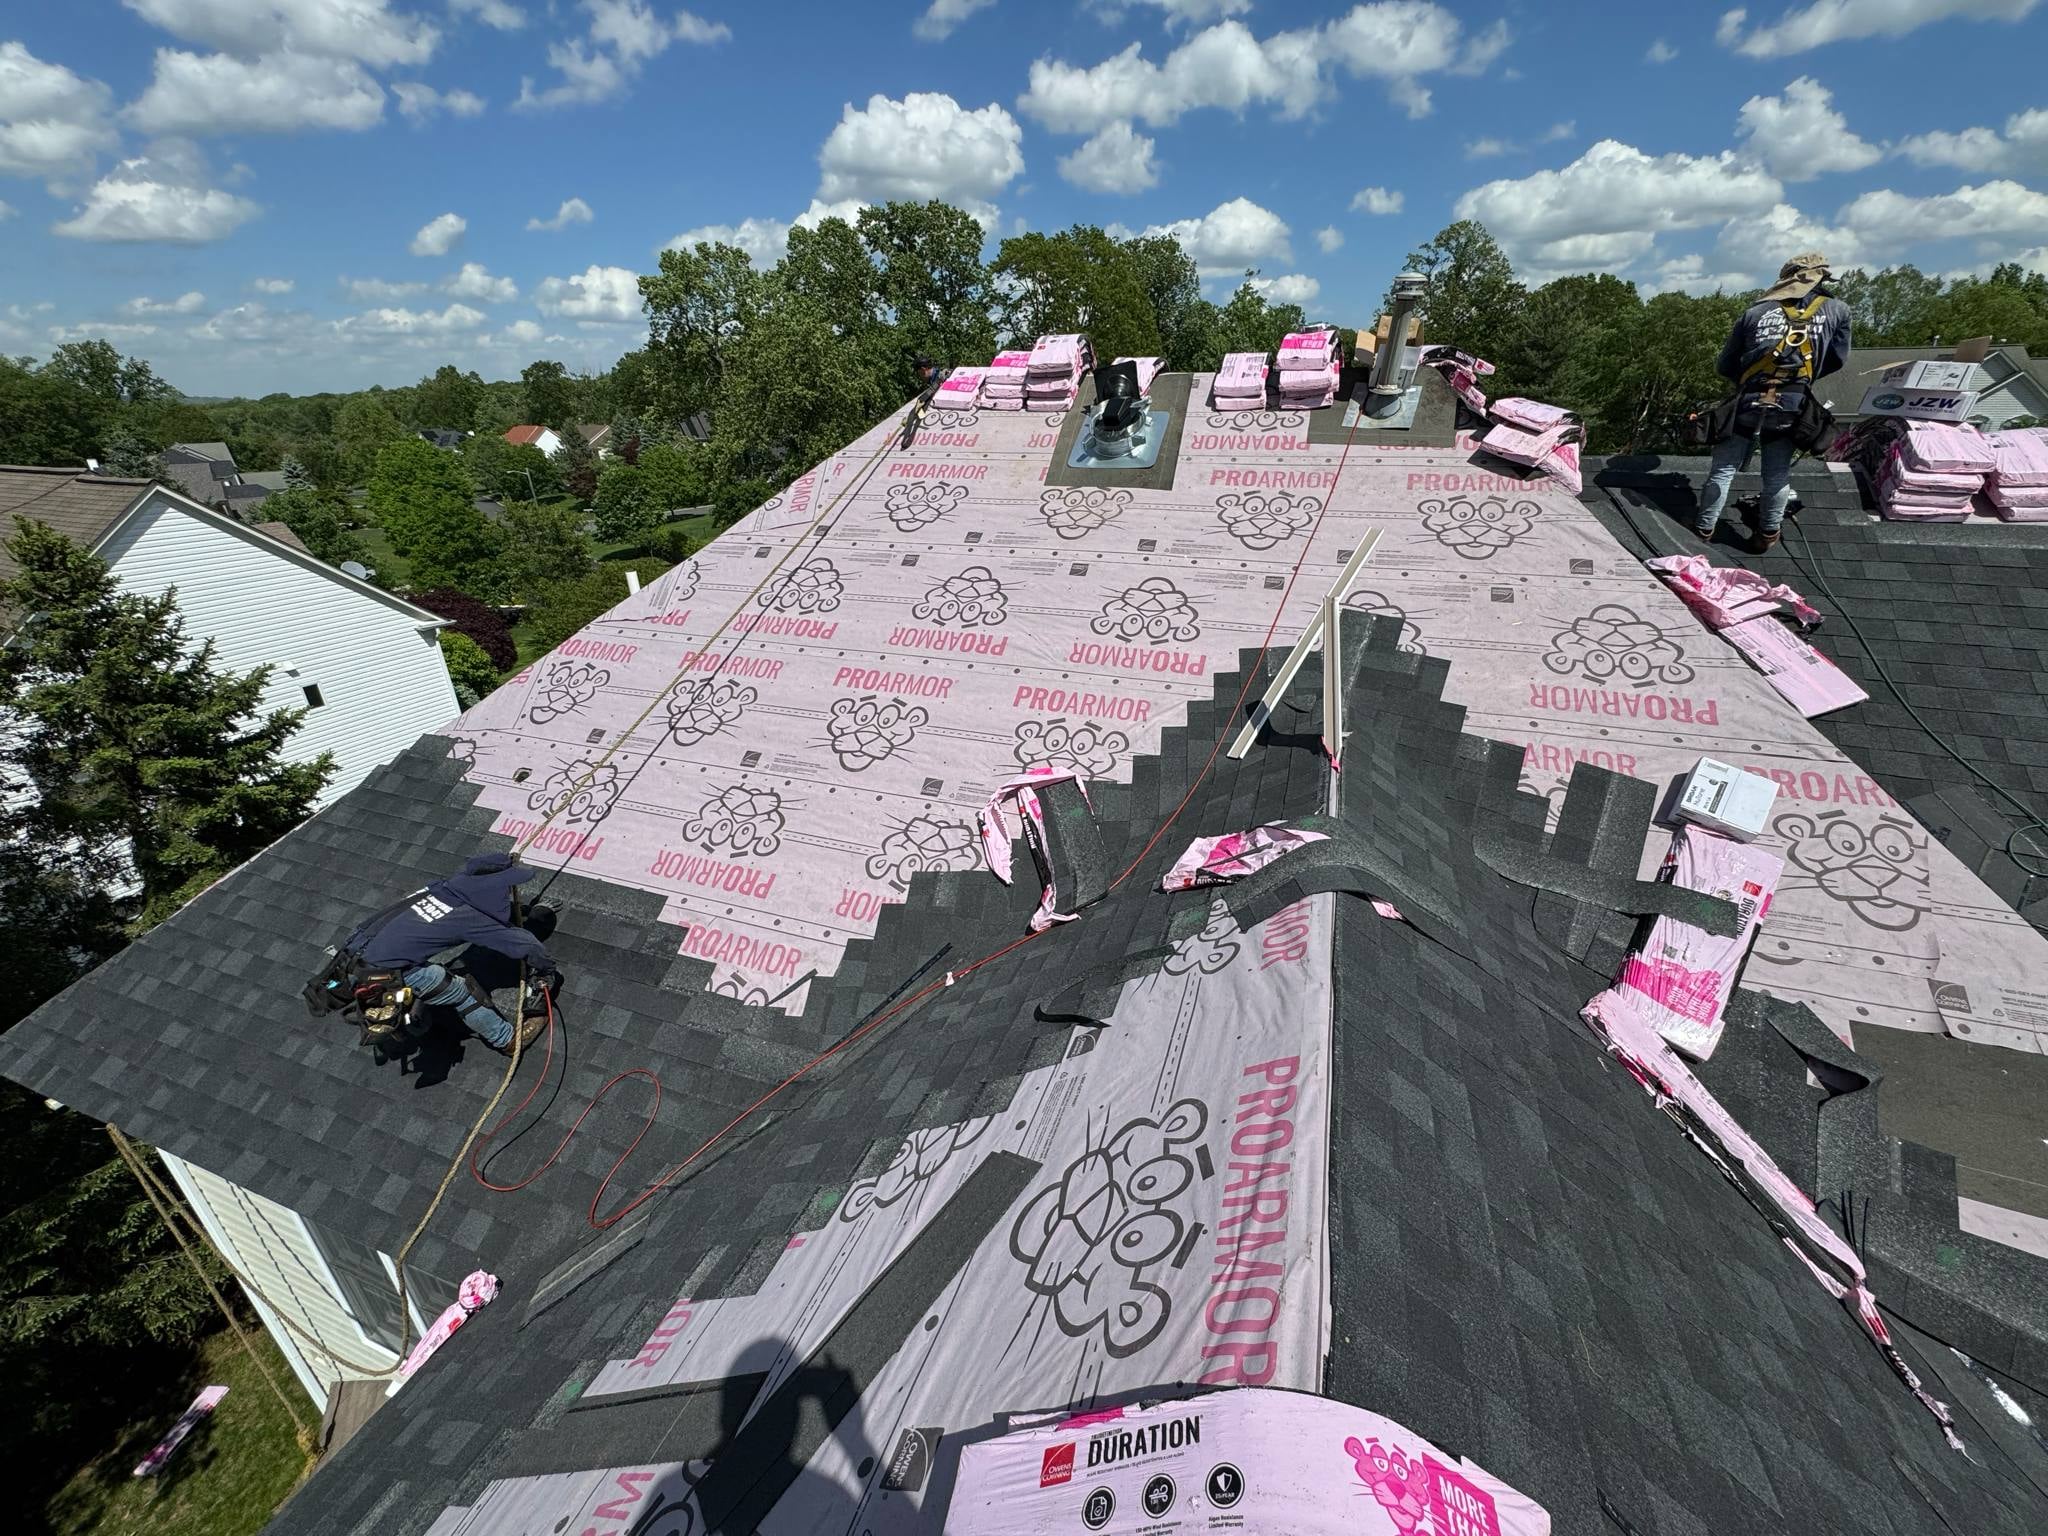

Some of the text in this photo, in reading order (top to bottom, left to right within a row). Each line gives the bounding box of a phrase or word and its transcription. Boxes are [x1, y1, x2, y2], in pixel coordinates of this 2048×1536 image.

[1906, 406, 1956, 414] INTERNATIONAL
[1909, 396, 1961, 409] JZW
[1191, 434, 1309, 450] PROARMOR
[887, 463, 988, 480] PROARMOR
[1210, 469, 1338, 488] PROARMOR
[732, 613, 838, 640] PROARMOR
[888, 627, 1008, 657] PROARMOR
[677, 650, 784, 680] PROARMOR
[1068, 642, 1207, 676] PROARMOR
[832, 666, 955, 698] PROARMOR
[1012, 685, 1151, 722] PROARMOR
[1529, 683, 1720, 727] PROARMOR
[649, 849, 778, 900] PROARMOR
[680, 919, 802, 978] ROARMOR
[1198, 1055, 1301, 1386] PROARMOR
[1087, 1415, 1200, 1467] DURATION
[886, 1432, 915, 1487] CORNING
[894, 1442, 918, 1487] OWENS
[1048, 1462, 1072, 1474] OWENS
[1042, 1470, 1071, 1482] CORNING
[1438, 1475, 1490, 1530] MORE
